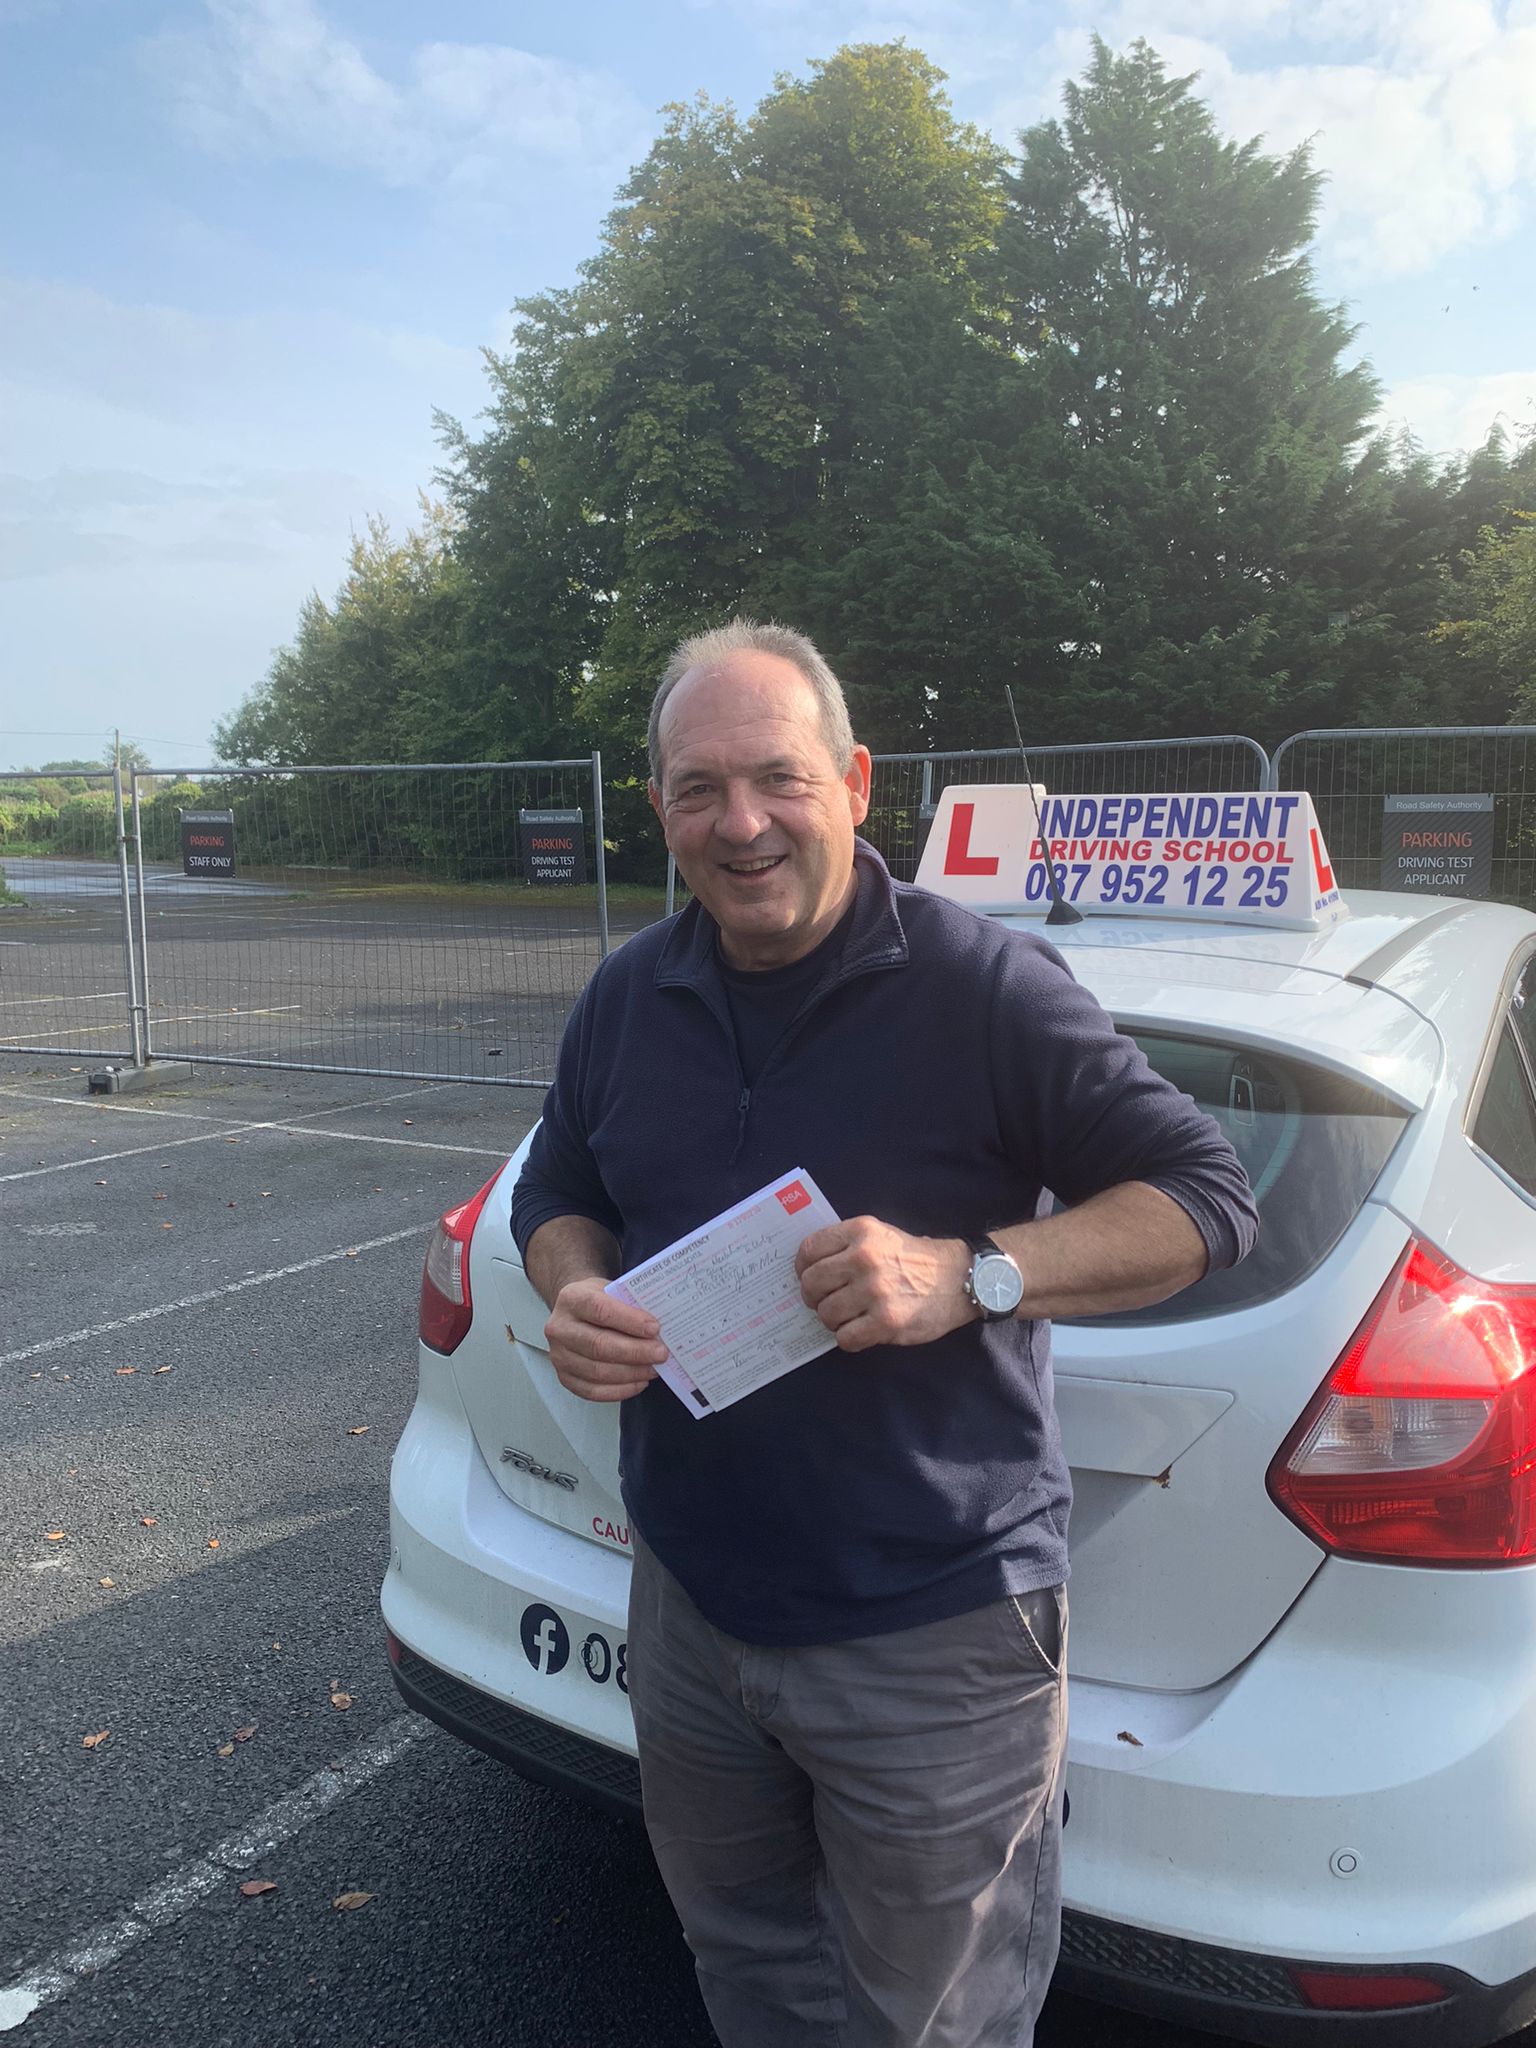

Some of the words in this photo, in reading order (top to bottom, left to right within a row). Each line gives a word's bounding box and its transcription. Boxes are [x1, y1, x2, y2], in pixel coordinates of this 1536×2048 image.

[1420, 802, 1444, 810] Safety
[1447, 801, 1482, 810] Authority
[1037, 797, 1299, 838] INDEPENDENT
[190, 835, 225, 846] PARKING
[532, 838, 573, 849] PARKING
[943, 803, 999, 876] L
[1402, 832, 1472, 848] PARKING
[1029, 840, 1152, 861] DRIVING
[1162, 840, 1294, 863] SCHOOL
[189, 856, 210, 867] STAFF
[211, 857, 231, 867] ONLY
[531, 856, 559, 865] DRIVING
[560, 856, 575, 865] TEST
[1310, 828, 1333, 893] L
[1398, 857, 1444, 868] DRIVING
[1448, 857, 1475, 868] TEST
[537, 869, 573, 878] APPLICANT
[1404, 874, 1466, 885] APPLICANT
[1025, 863, 1092, 901] 087
[1100, 864, 1169, 904] 952
[1183, 865, 1228, 906] 12
[1238, 866, 1290, 908] 25
[781, 1189, 803, 1206] RSA
[629, 1262, 664, 1287] CERTIFICATE
[671, 1234, 711, 1262] COMPETENCY
